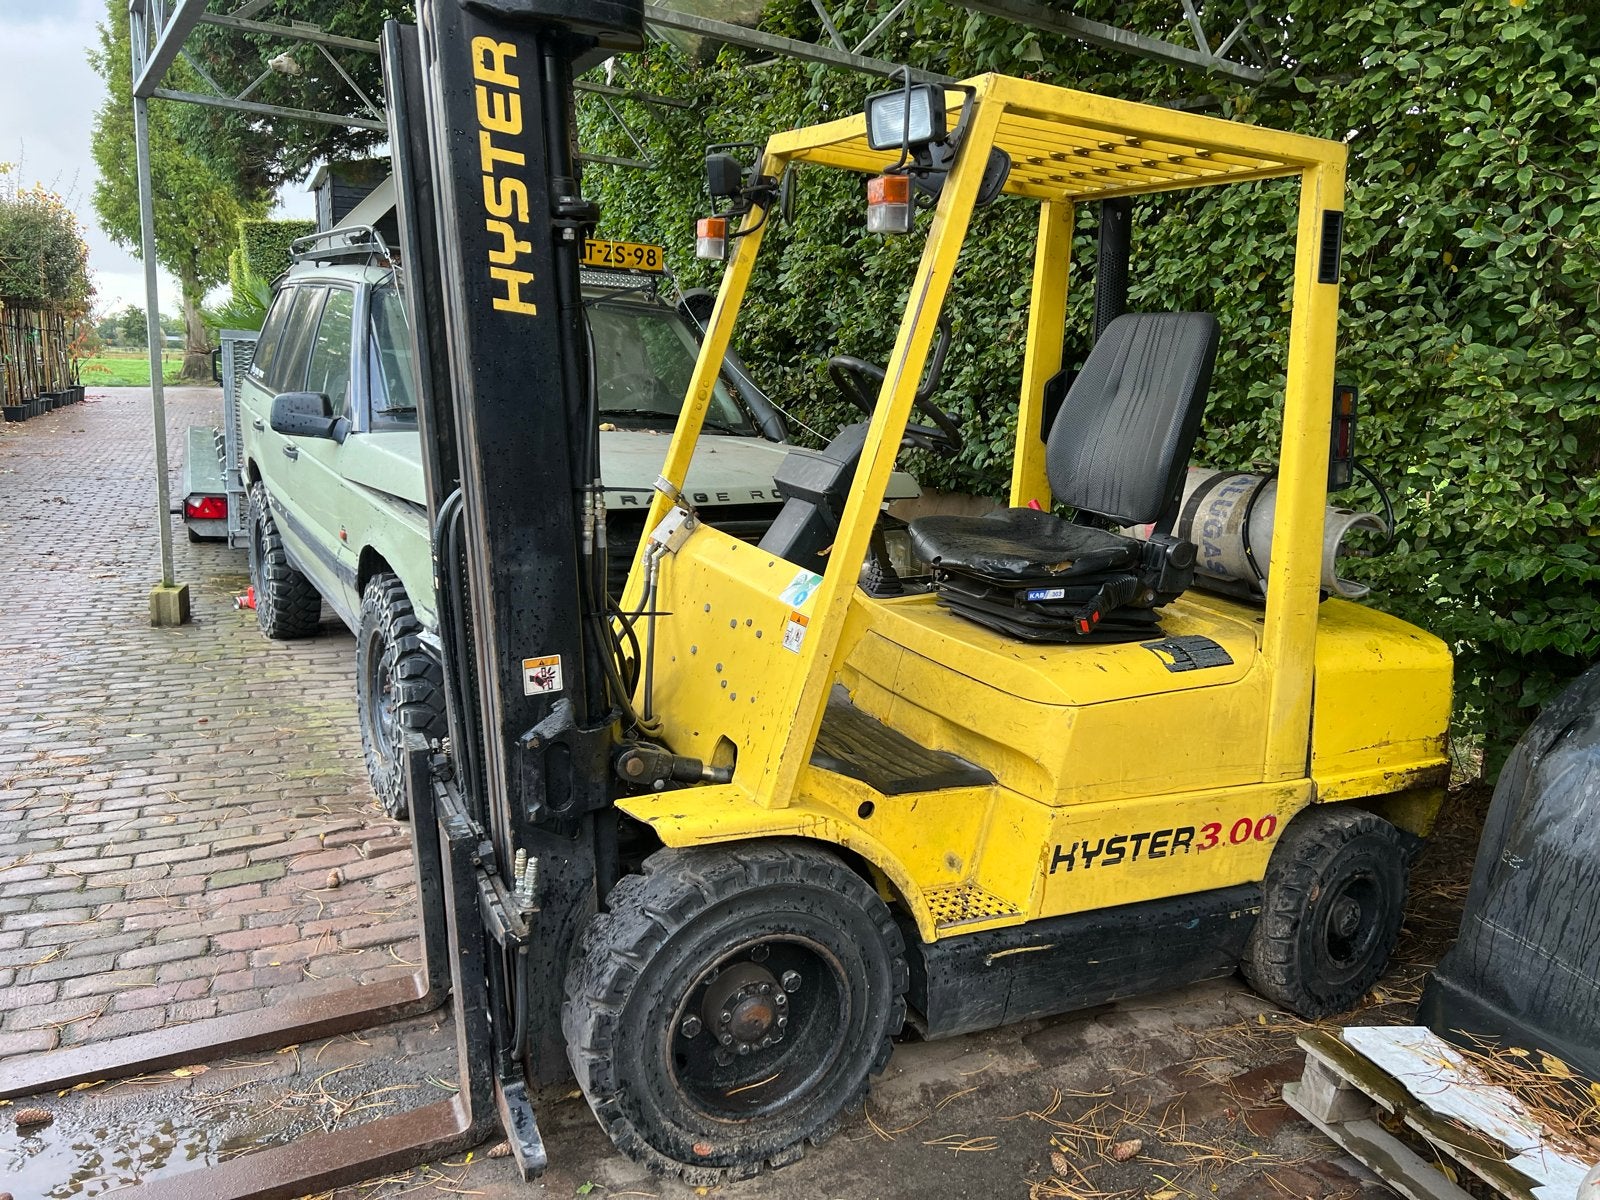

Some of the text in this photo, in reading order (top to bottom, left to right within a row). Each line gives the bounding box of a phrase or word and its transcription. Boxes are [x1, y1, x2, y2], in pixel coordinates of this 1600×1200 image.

[471, 36, 537, 316] HYSTER
[585, 243, 657, 267] T-ZS-98
[620, 492, 730, 505] RGE
[1203, 477, 1255, 575] ALUGAS
[1049, 814, 1277, 875] HYSTER 3.00
